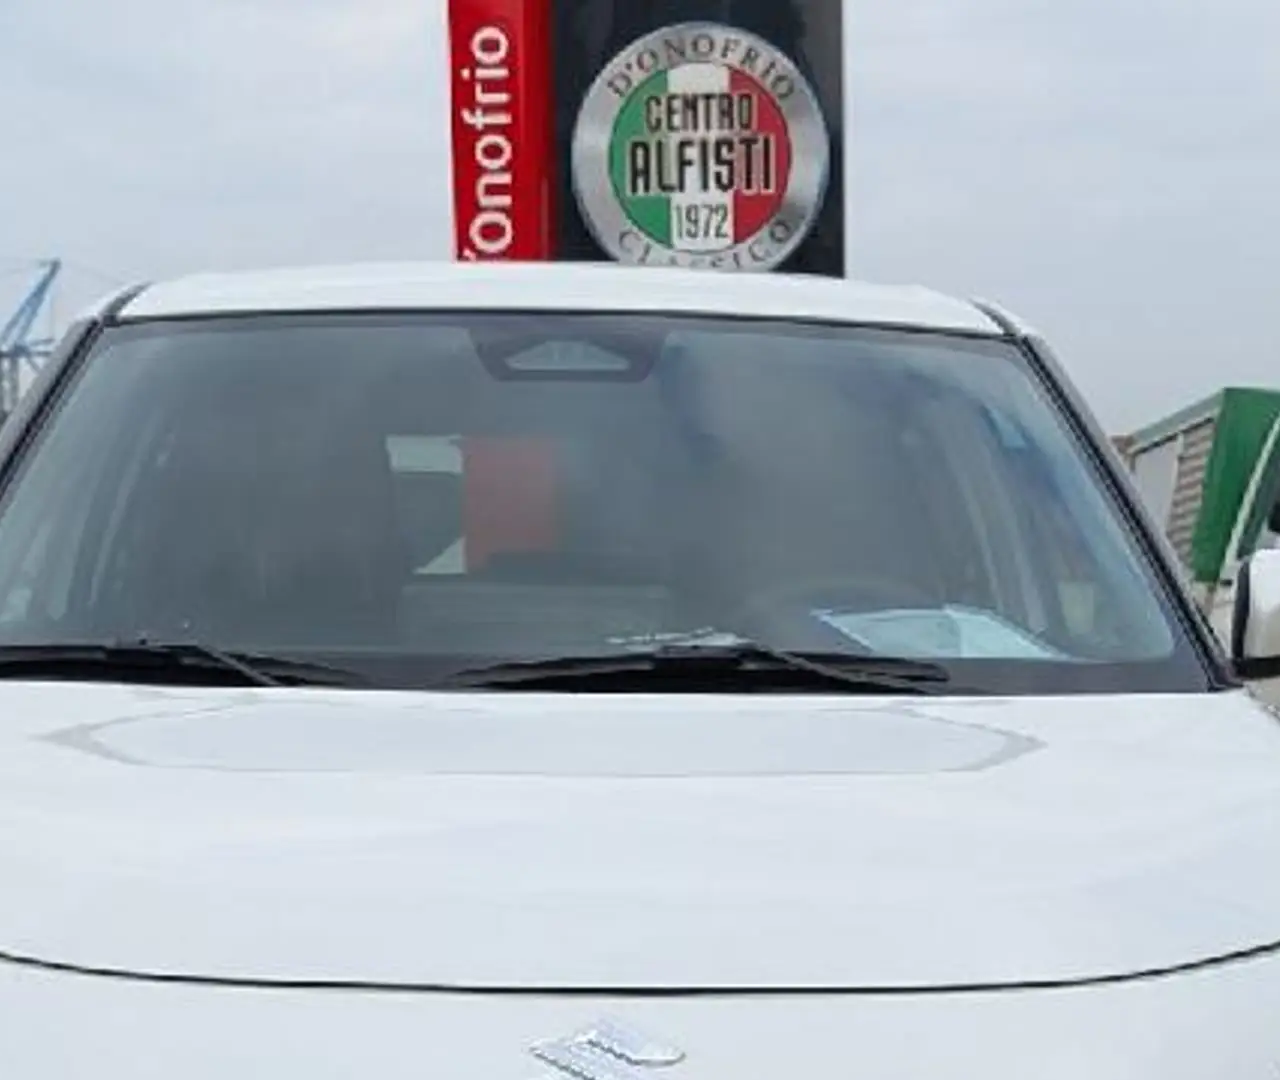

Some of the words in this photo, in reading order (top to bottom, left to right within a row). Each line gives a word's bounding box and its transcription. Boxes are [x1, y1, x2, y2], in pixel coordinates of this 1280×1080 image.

[607, 33, 795, 98] D'ONOFRIO
[645, 93, 754, 133] CENTRO
[630, 137, 774, 194] ALFISTI
[675, 204, 729, 239] 1972
